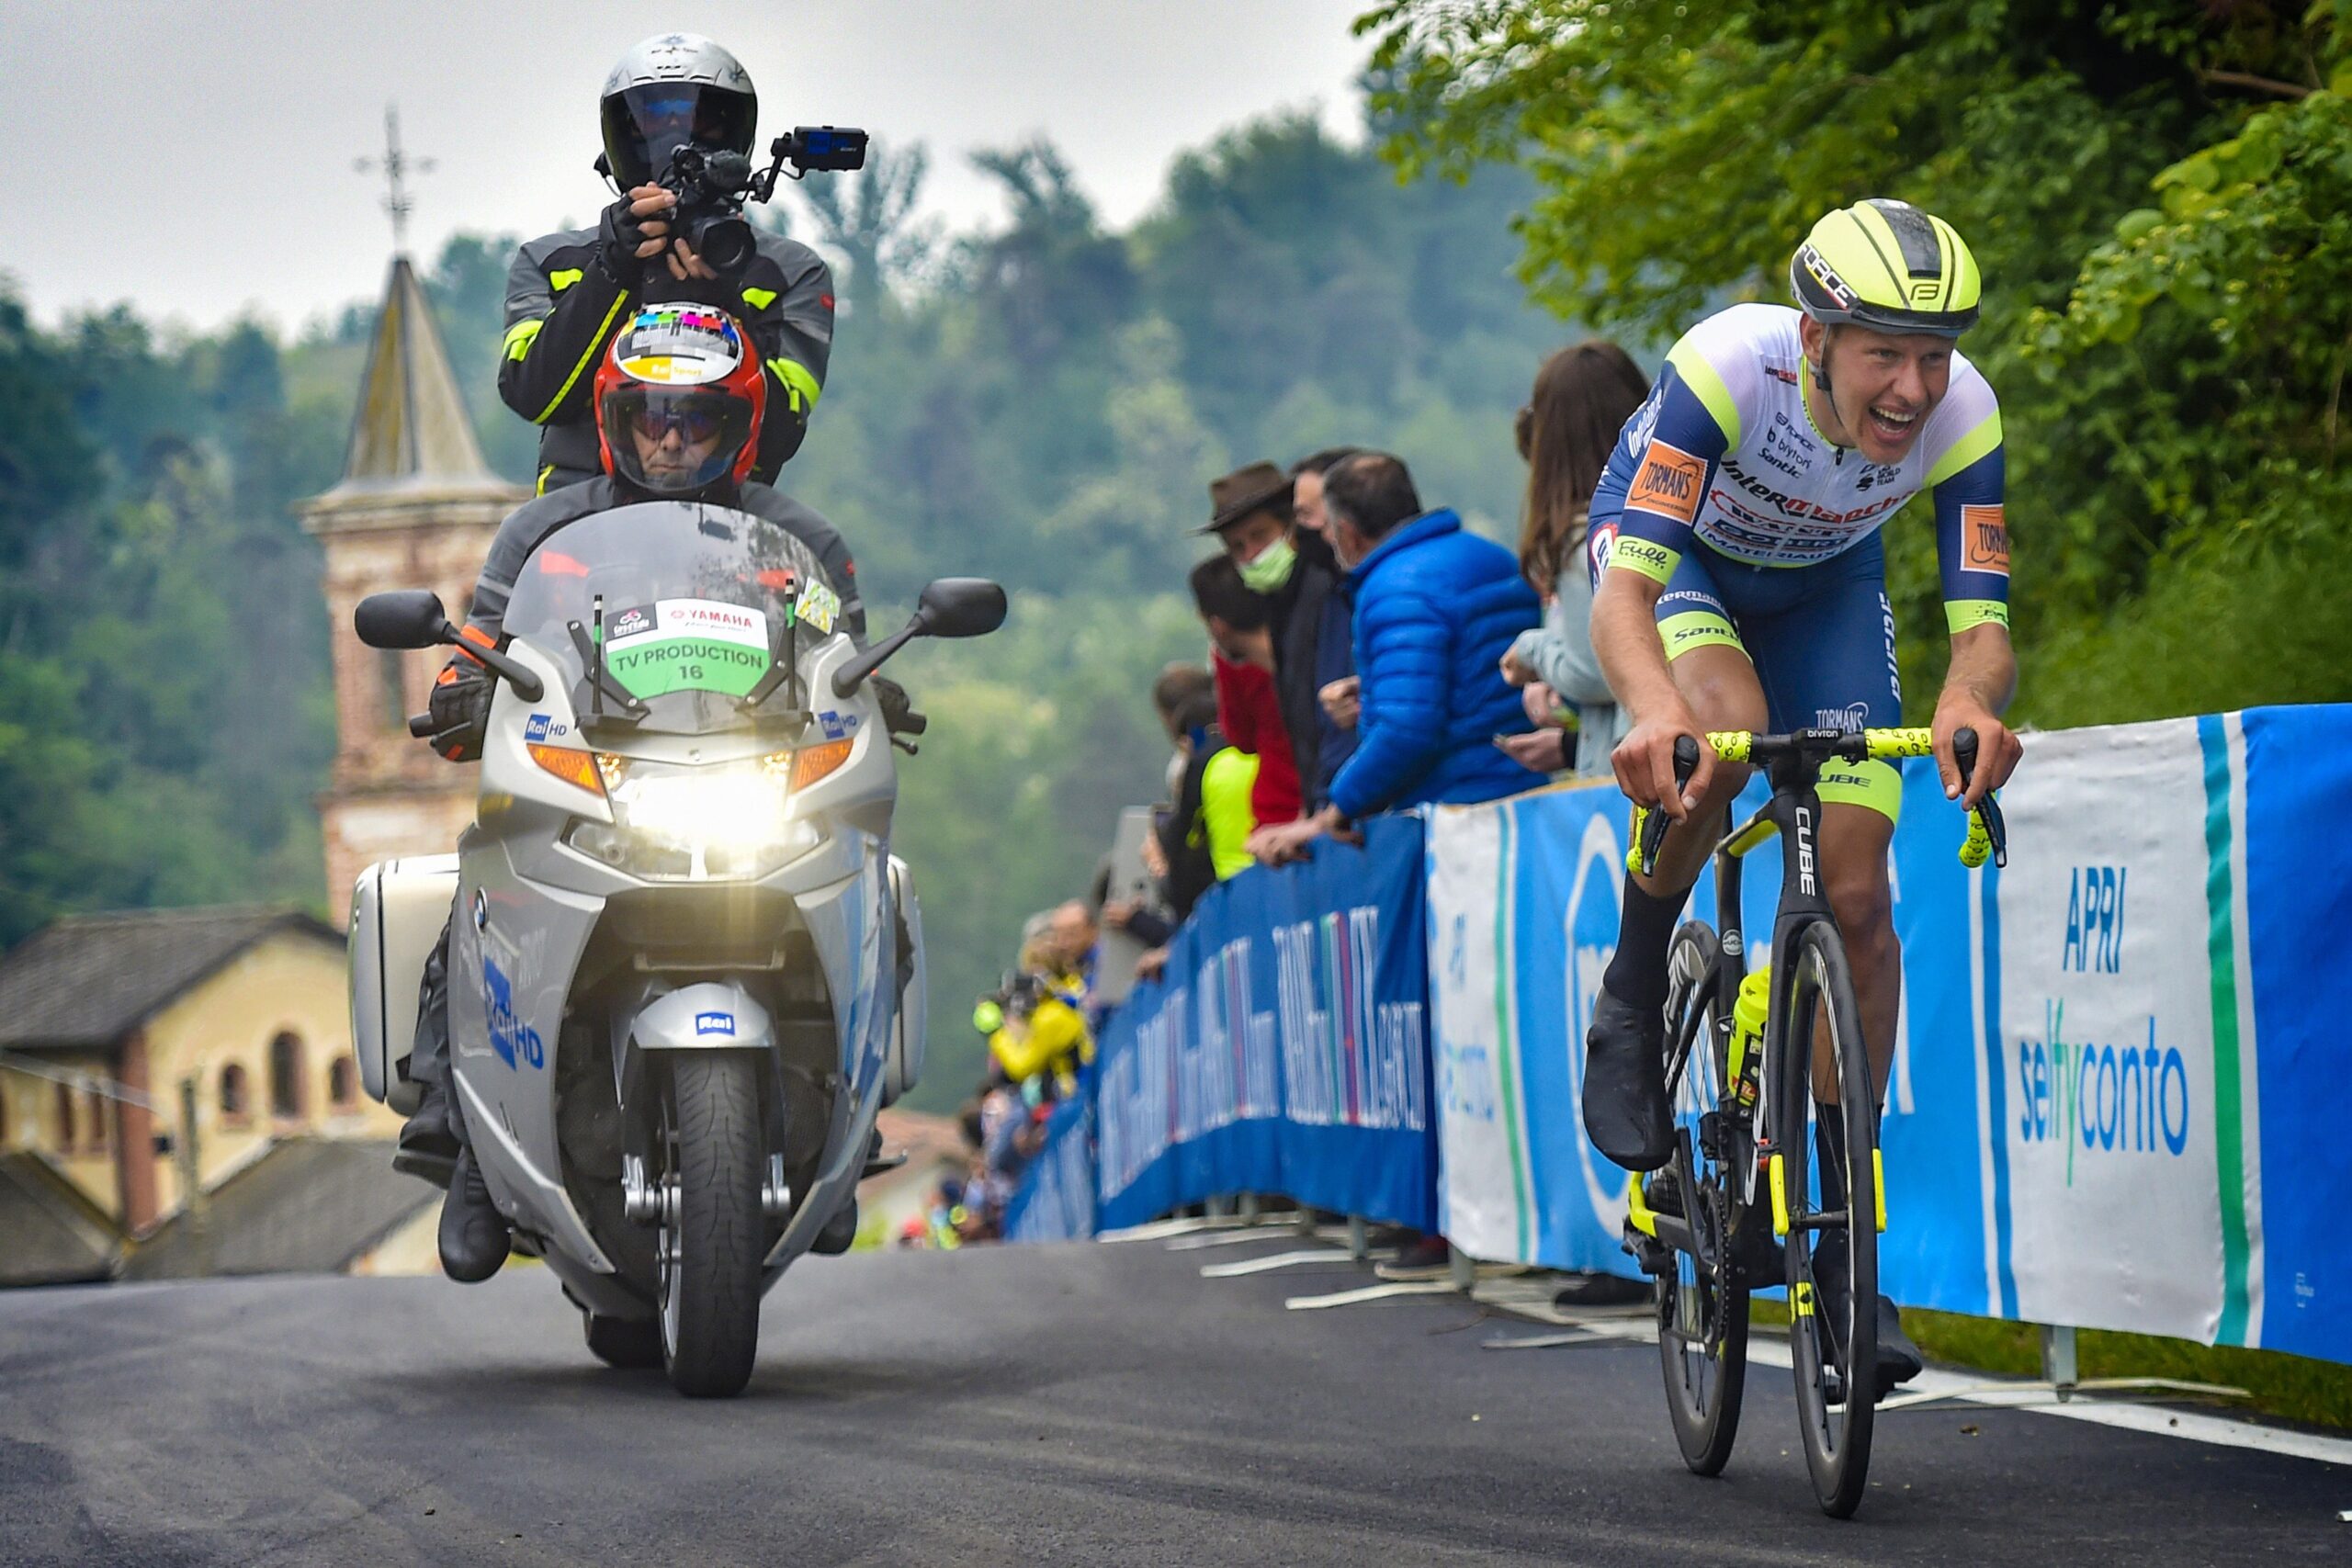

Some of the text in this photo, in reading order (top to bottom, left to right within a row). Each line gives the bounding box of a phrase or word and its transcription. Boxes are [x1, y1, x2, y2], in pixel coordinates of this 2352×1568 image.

[1758, 447, 1803, 479] Santic
[1778, 438, 1812, 469] bryton
[1640, 461, 1693, 501] TORMANS
[689, 610, 752, 628] YAMAHA
[616, 645, 763, 671] TV PRODUCTION
[679, 665, 704, 680] 16
[527, 720, 567, 736] Rai HD
[1815, 708, 1864, 734] TORMANS
[1819, 774, 1871, 788] UBE
[1795, 807, 1815, 897] CUBE
[2064, 866, 2126, 974] APRI
[698, 1016, 732, 1030] Rai
[514, 1014, 544, 1070] HD
[2020, 998, 2189, 1188] selfyconto
